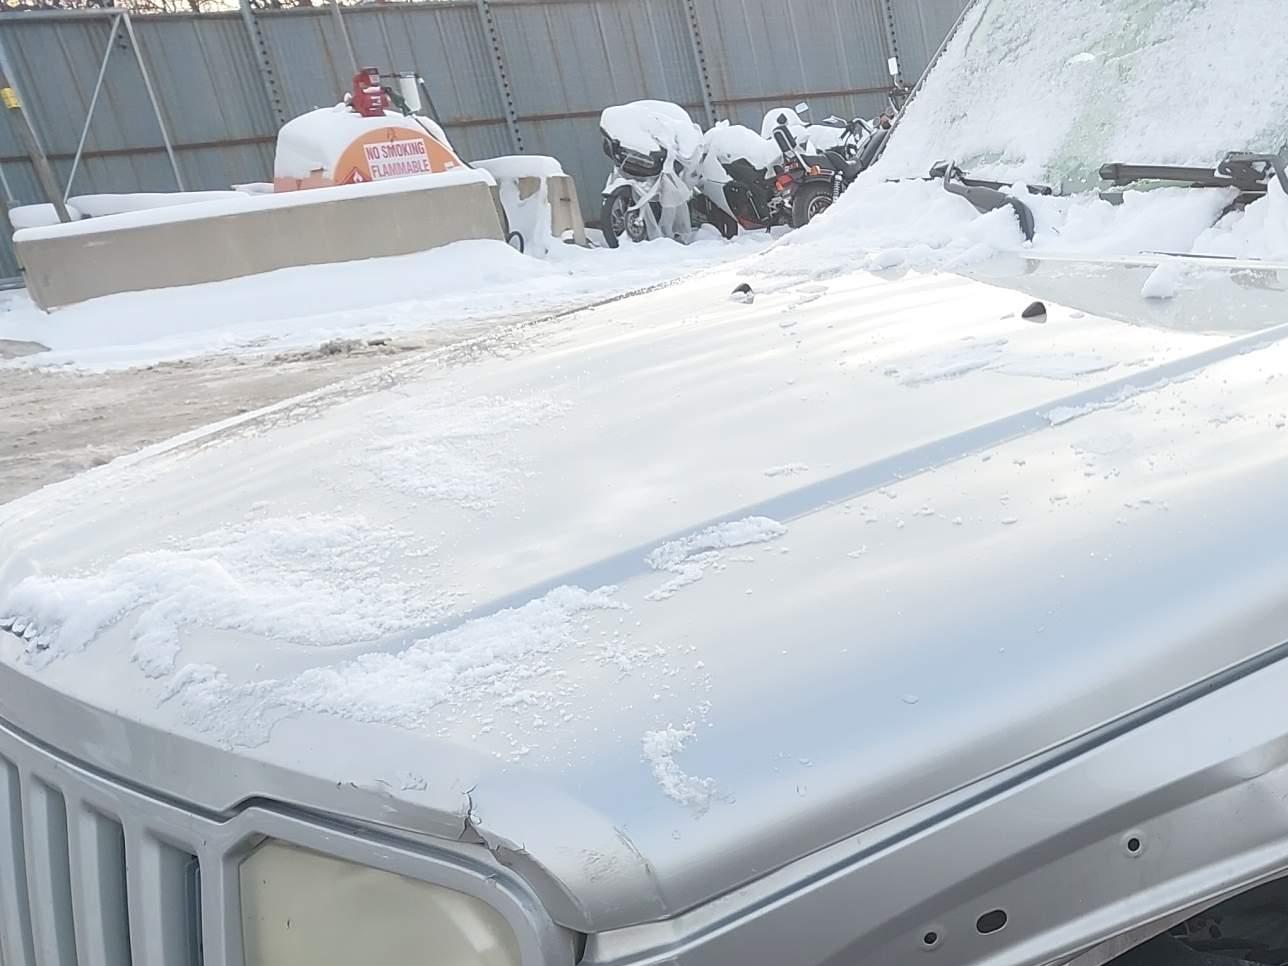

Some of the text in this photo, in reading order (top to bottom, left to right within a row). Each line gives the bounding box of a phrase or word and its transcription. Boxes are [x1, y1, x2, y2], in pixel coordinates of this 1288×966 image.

[366, 141, 426, 160] NO SMOKING
[372, 160, 430, 179] FLAMMABLE
